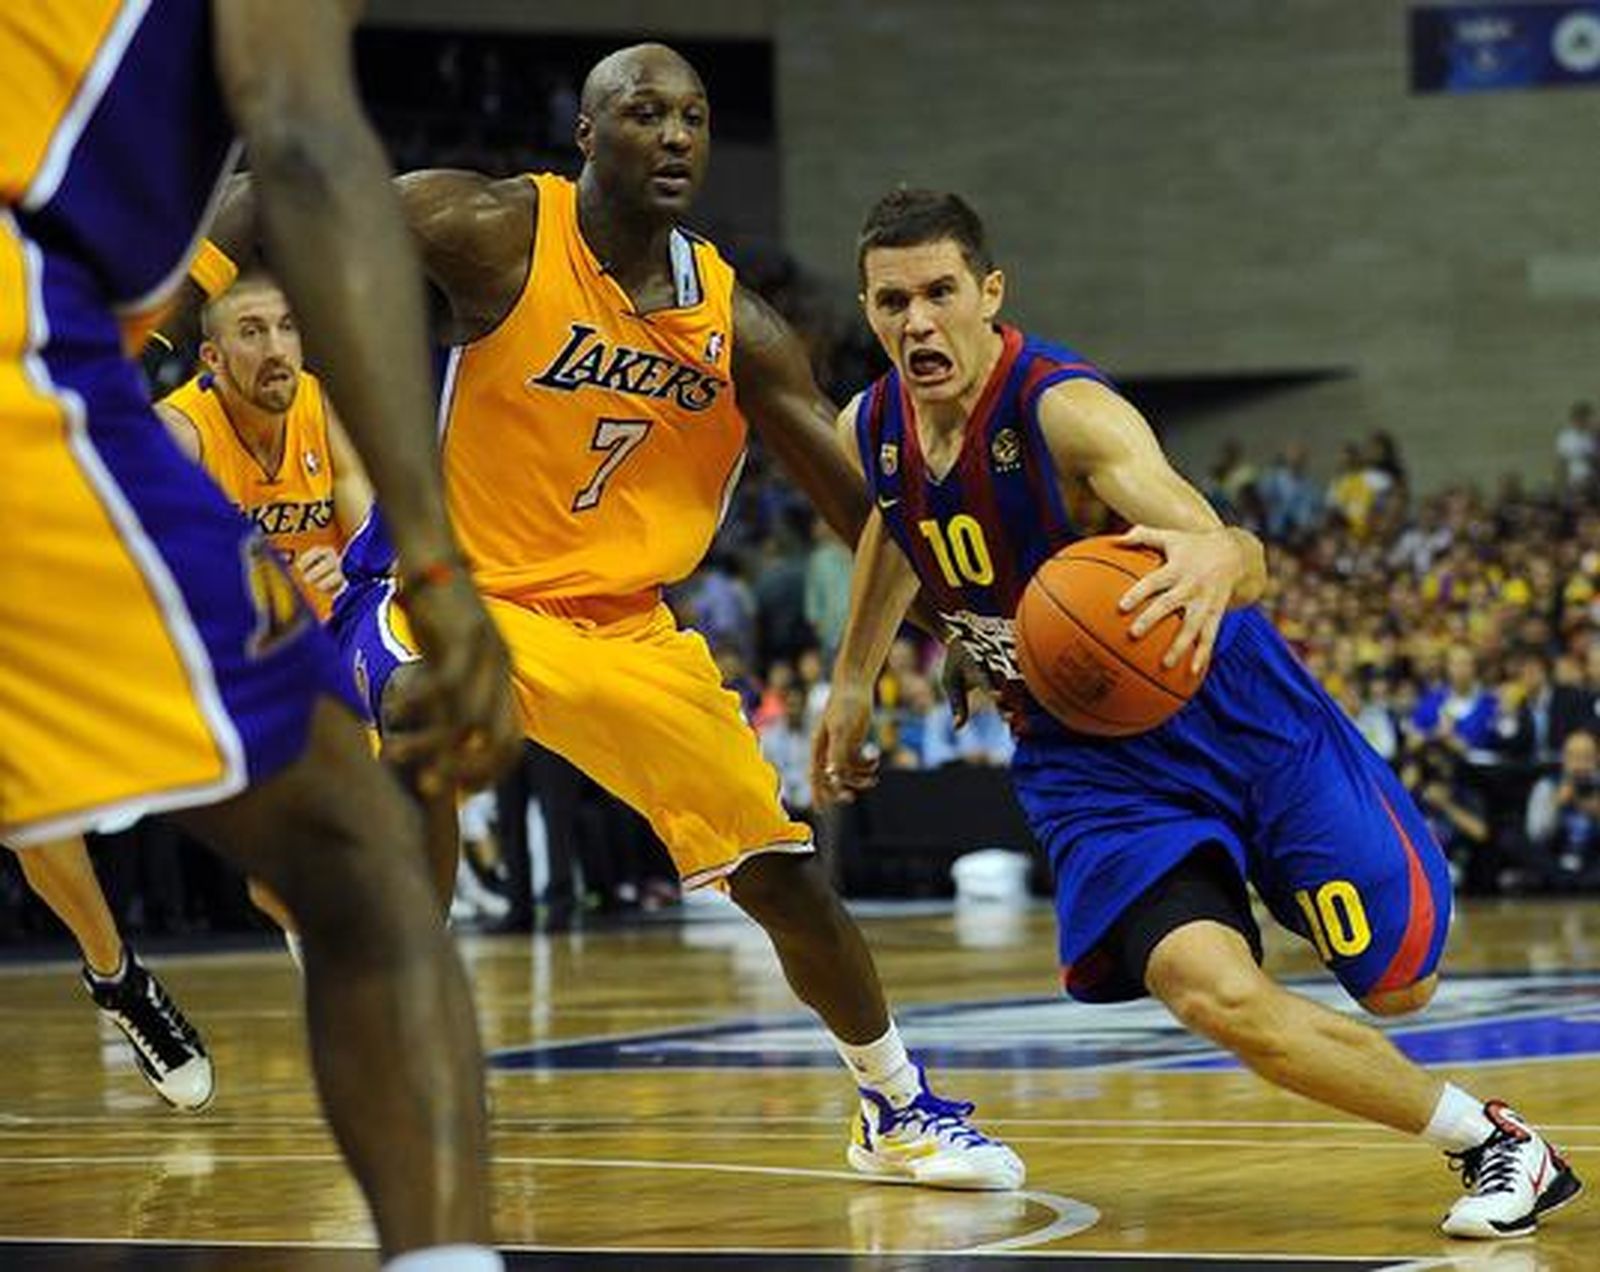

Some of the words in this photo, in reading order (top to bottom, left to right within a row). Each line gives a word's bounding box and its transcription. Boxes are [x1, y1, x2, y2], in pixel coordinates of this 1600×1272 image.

[525, 322, 729, 412] LAKERS
[570, 416, 654, 513] 7
[234, 499, 335, 535] KERS
[918, 514, 995, 588] 10
[1294, 880, 1372, 962] 10
